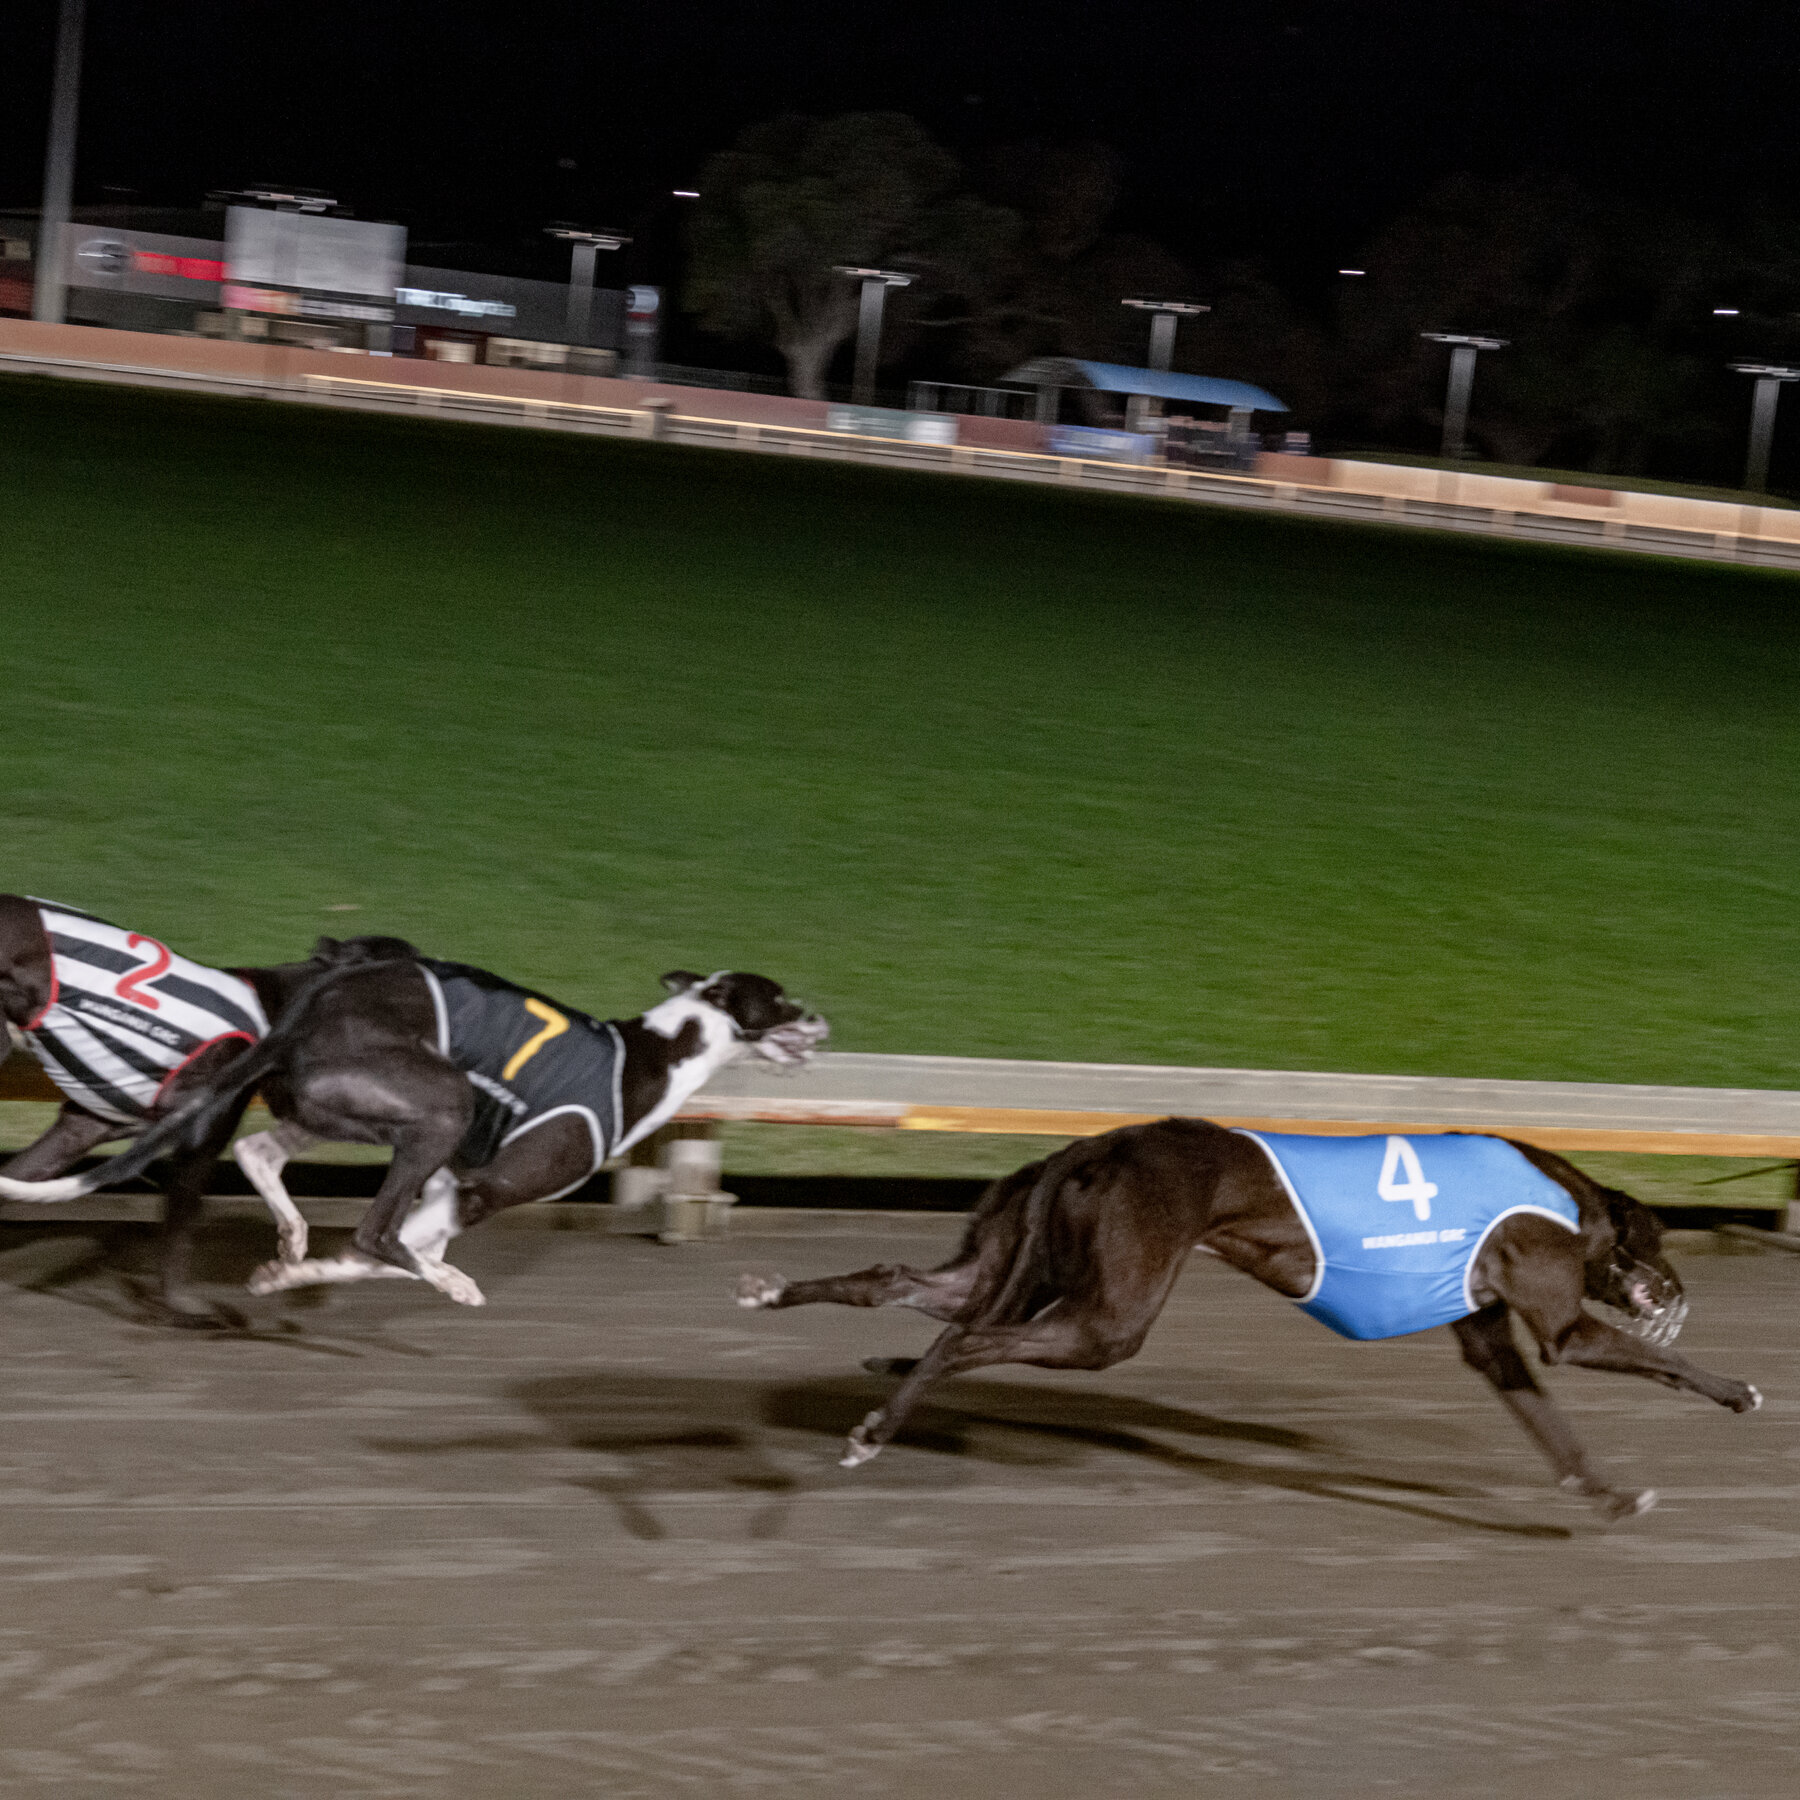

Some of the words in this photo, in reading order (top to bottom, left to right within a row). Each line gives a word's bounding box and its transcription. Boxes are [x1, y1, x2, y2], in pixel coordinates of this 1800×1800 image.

[115, 932, 171, 1011] 2
[502, 997, 570, 1081] 7
[1377, 1134, 1438, 1221] 4
